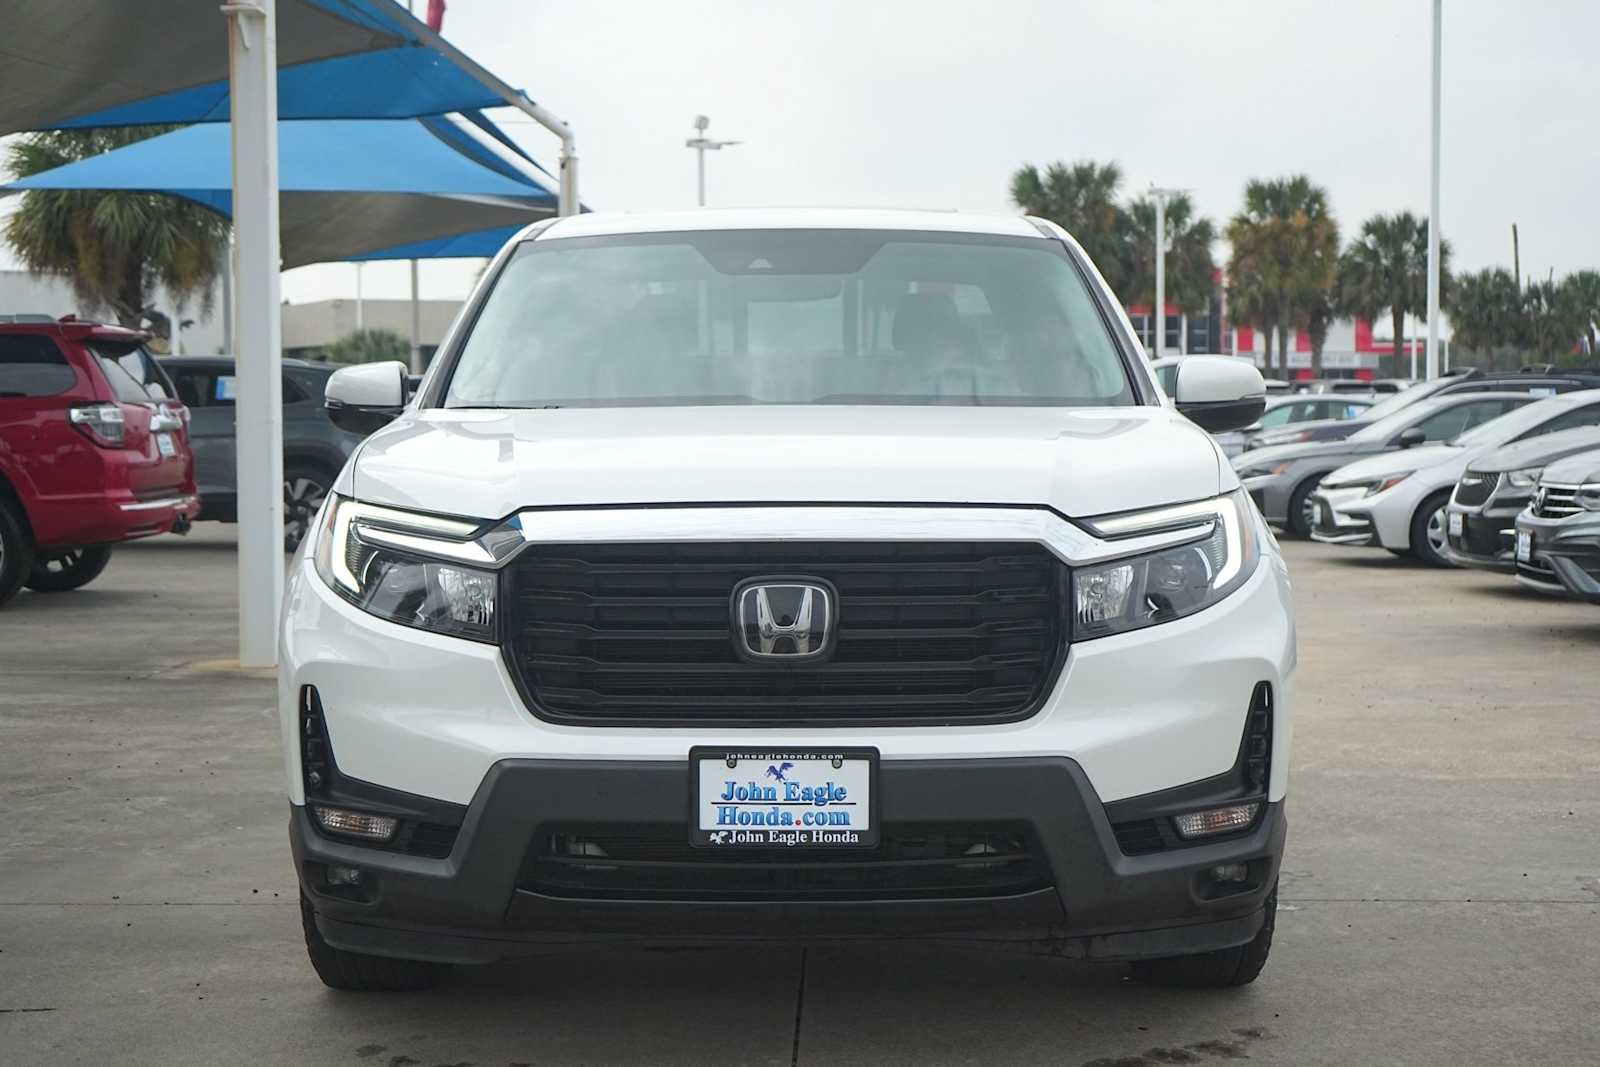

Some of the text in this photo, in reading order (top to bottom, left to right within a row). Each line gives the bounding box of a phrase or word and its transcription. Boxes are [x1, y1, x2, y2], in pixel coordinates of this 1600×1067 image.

[721, 781, 847, 806] John Eagle
[716, 806, 851, 826] Honda.com
[729, 831, 859, 845] John Eagle Honda
